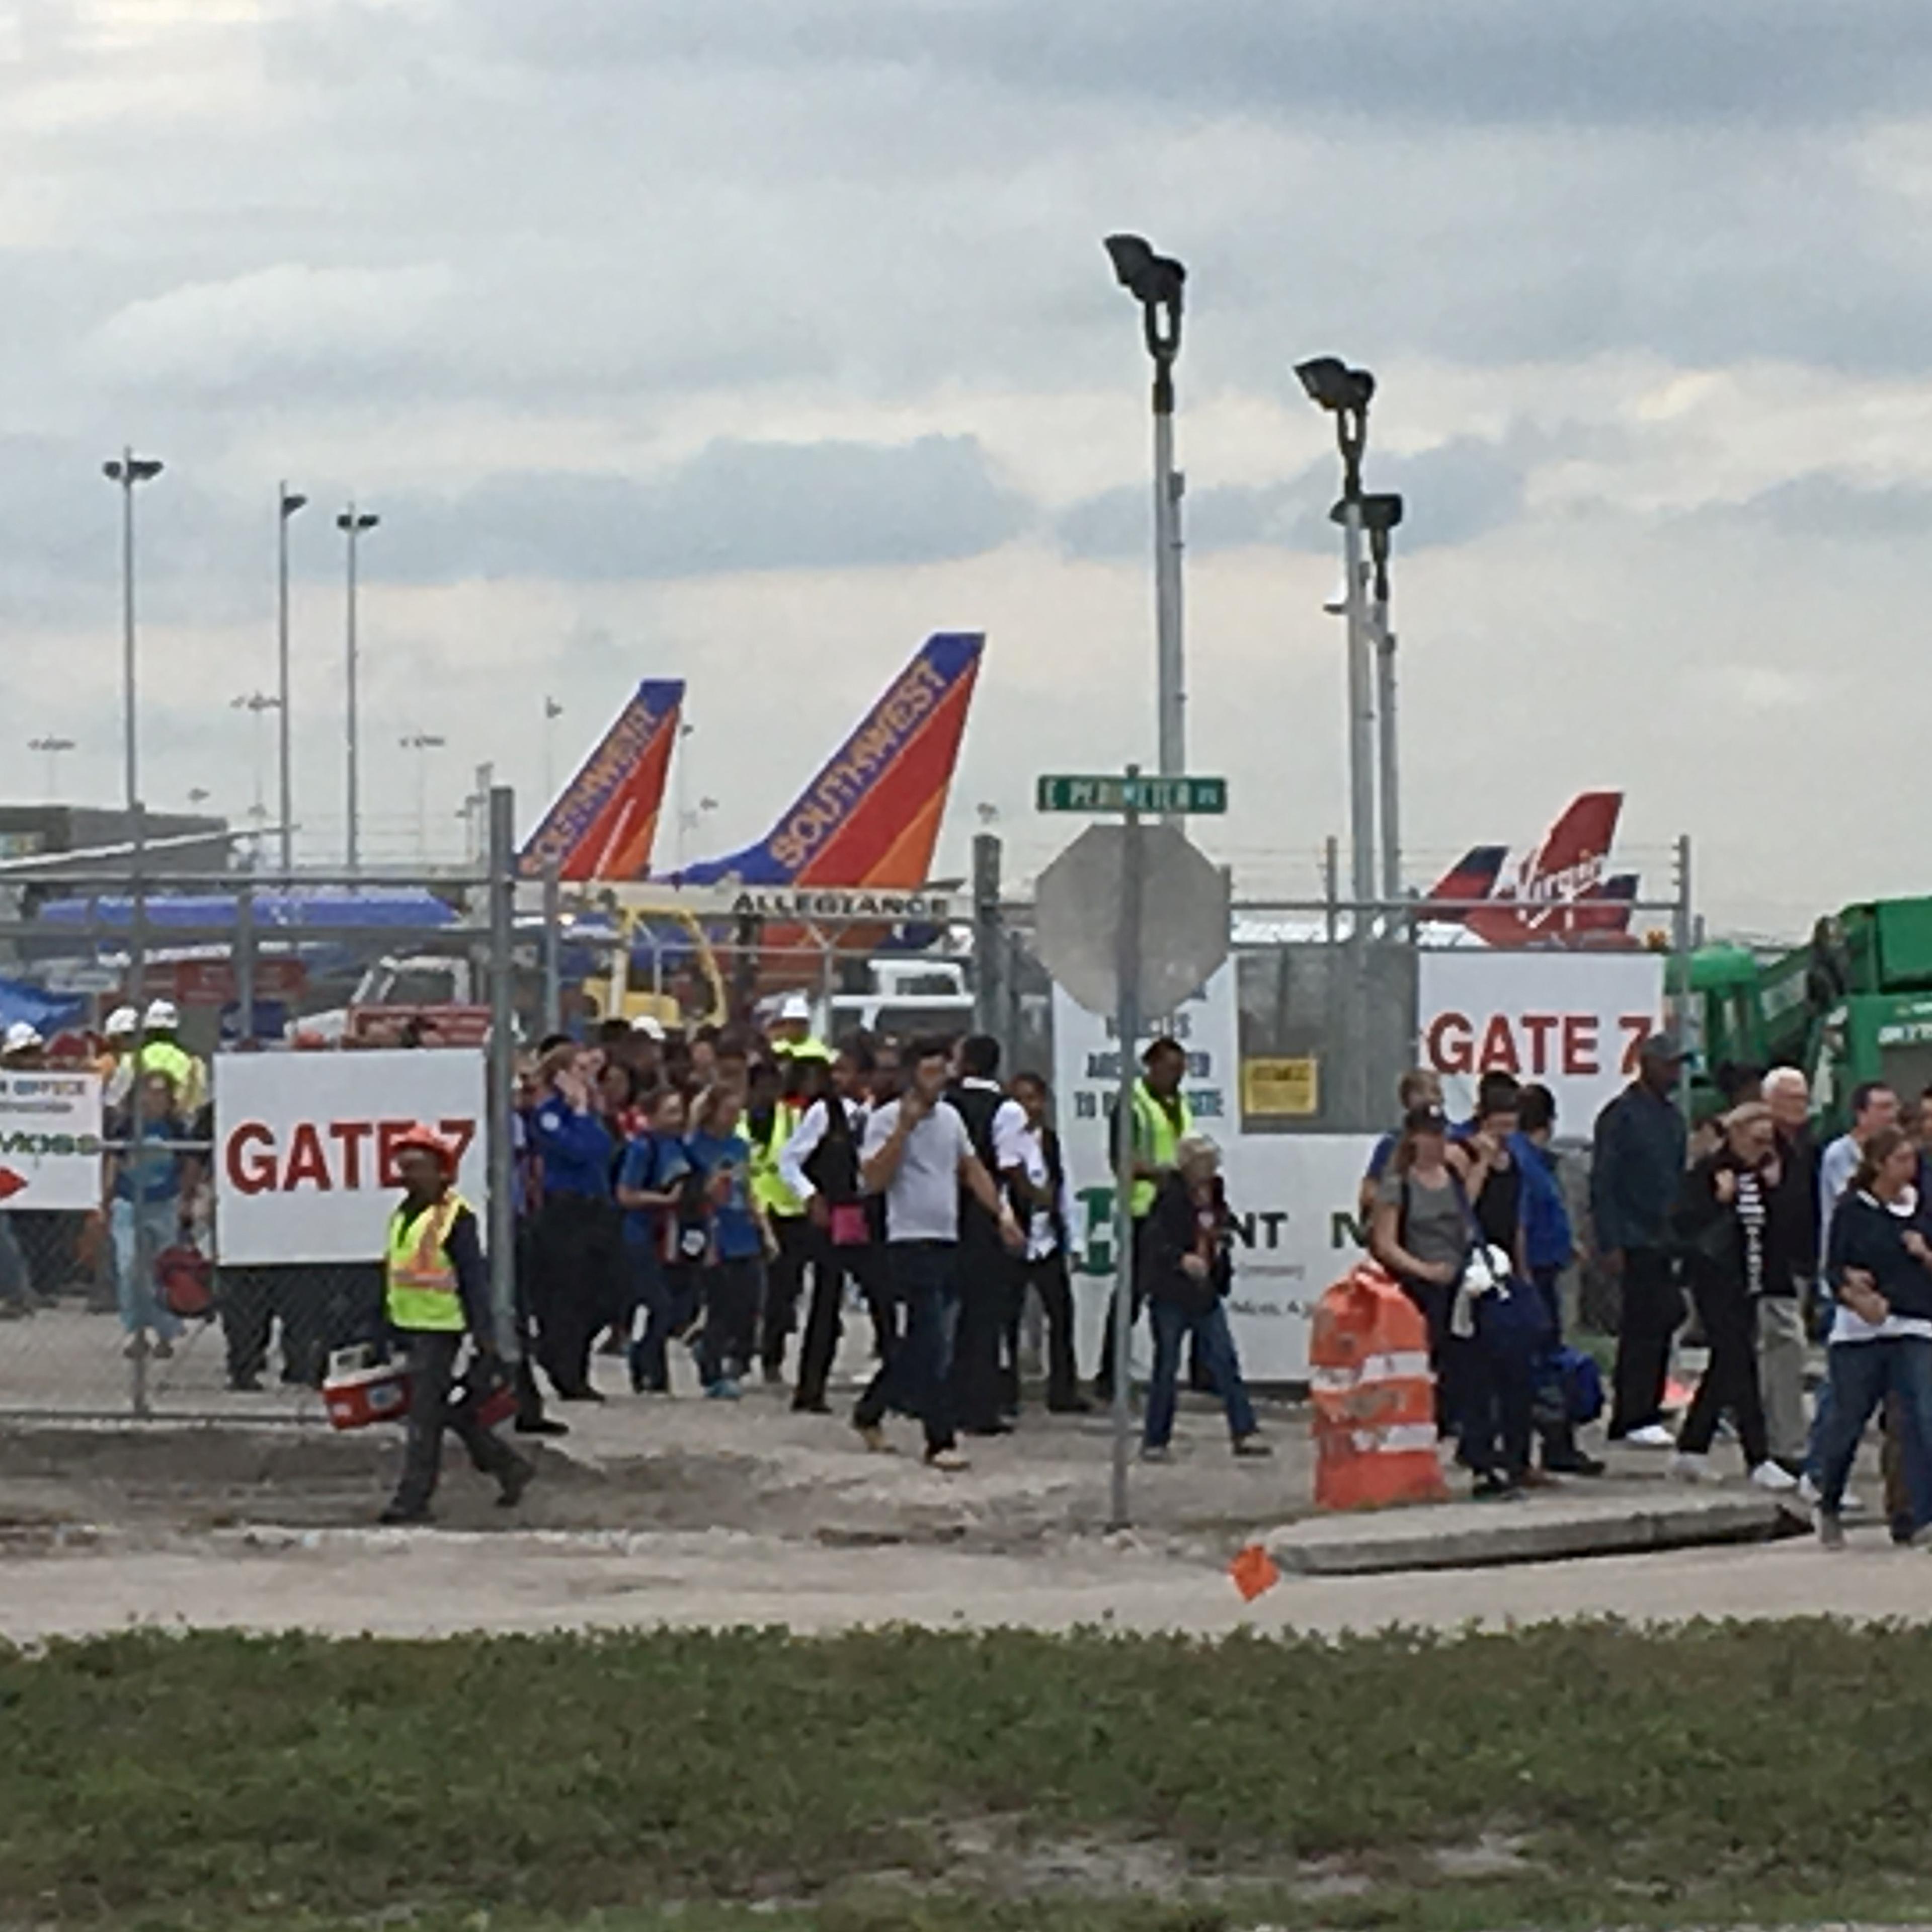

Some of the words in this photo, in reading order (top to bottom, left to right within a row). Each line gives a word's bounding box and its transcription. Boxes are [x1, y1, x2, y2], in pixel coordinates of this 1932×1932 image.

[1427, 1011, 1600, 1076] GATE
[1618, 1015, 1653, 1076] 7
[226, 1119, 418, 1194] GATE
[439, 1118, 476, 1190] 7
